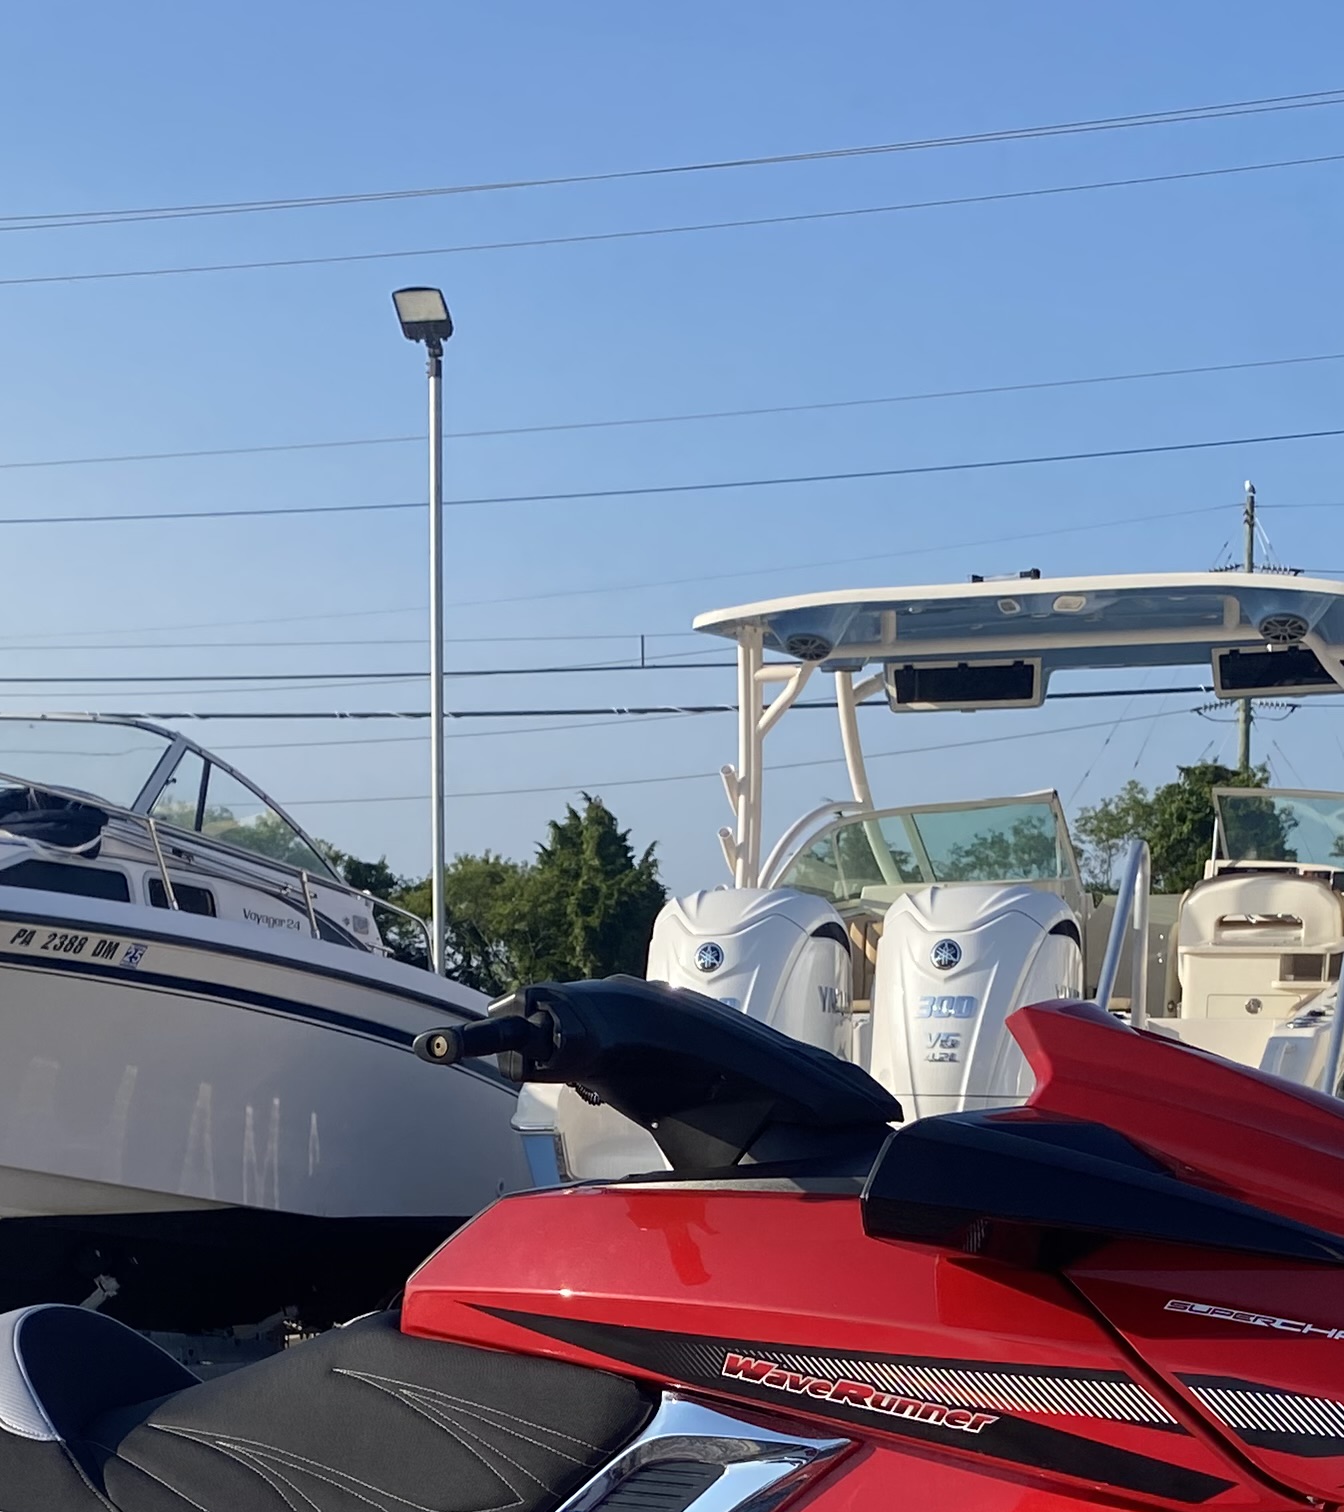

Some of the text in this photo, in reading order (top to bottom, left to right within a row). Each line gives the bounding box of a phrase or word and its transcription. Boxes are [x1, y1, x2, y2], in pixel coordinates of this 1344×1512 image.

[286, 919, 301, 931] 24
[10, 928, 120, 960] PA 2388 DM
[916, 995, 979, 1019] 300
[926, 1032, 961, 1049] V6
[722, 1353, 1001, 1433] WaveRunner
